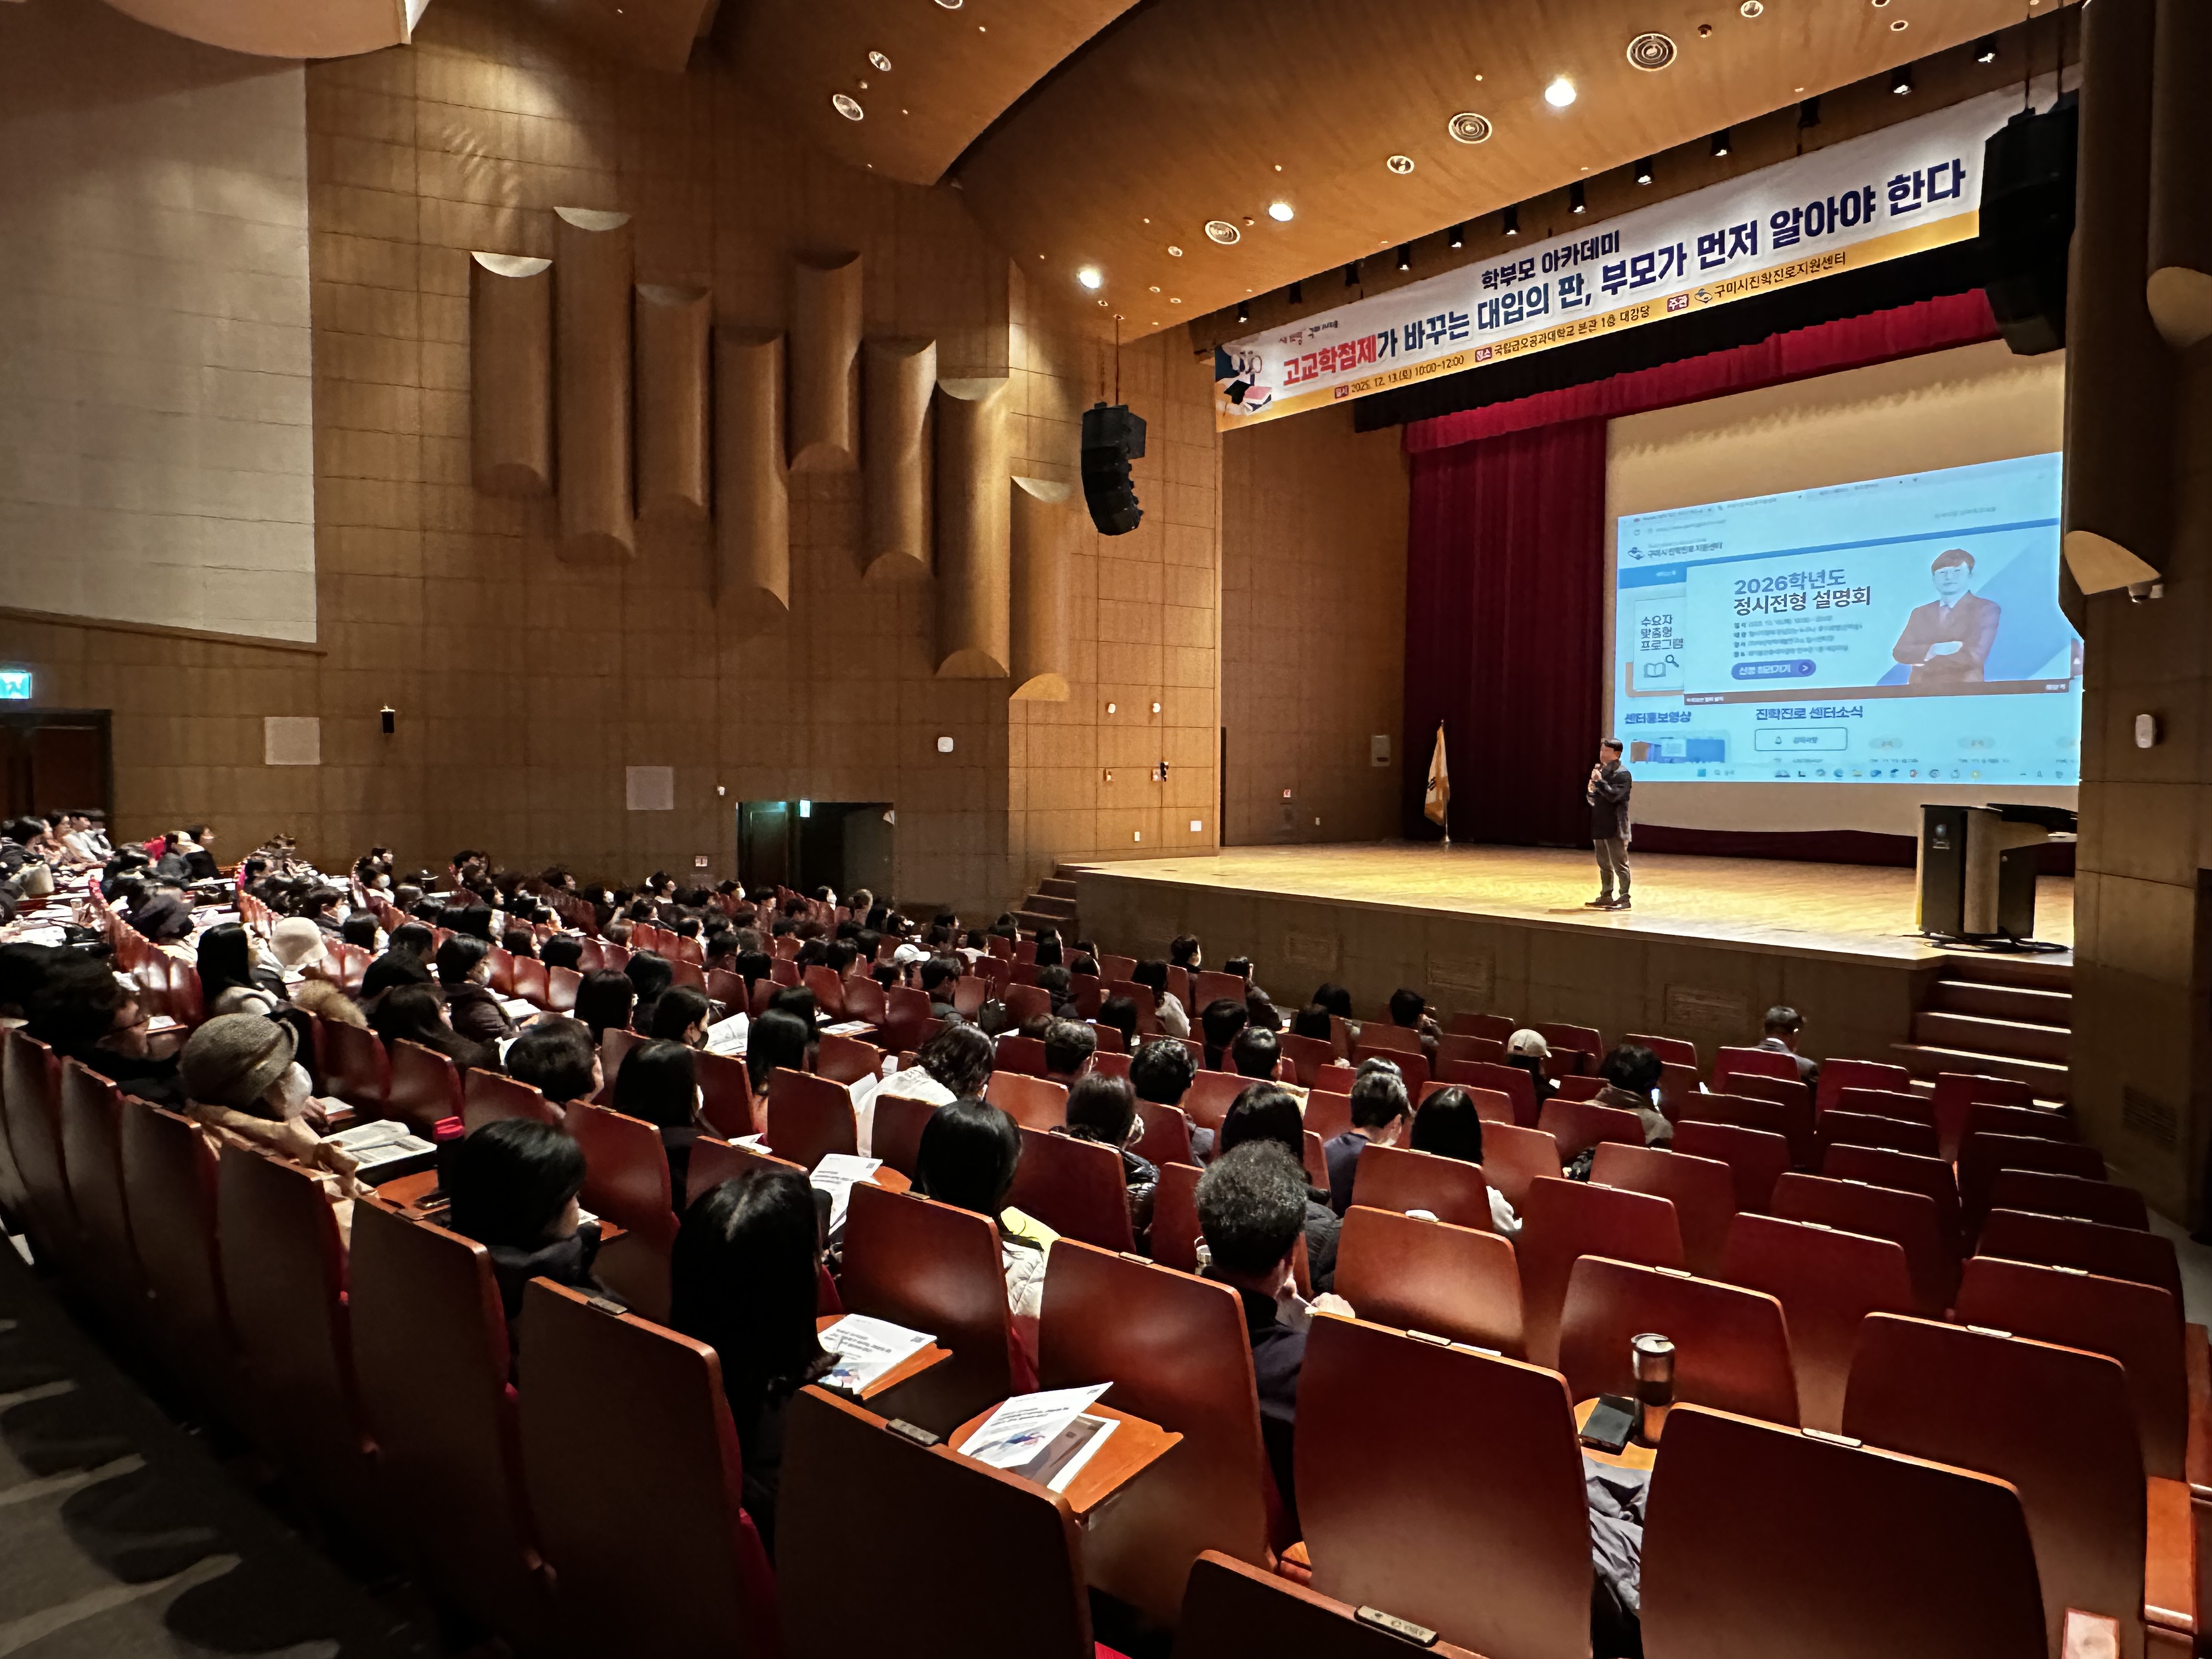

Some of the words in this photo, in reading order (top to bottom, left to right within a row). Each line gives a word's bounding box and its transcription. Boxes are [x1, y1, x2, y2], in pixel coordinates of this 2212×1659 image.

[1283, 329, 1397, 386] 고교학점제가
[1404, 311, 1470, 351] 바꾸는
[1477, 283, 1549, 330] 대입의
[1559, 273, 1592, 309] 판,
[1601, 242, 1687, 296] 부모가
[1697, 219, 1758, 270] 먼저
[1770, 185, 1876, 250] 알아야
[1887, 158, 1966, 217] 한다
[1482, 257, 1536, 290] 학부모
[1542, 229, 1620, 273] 아카데미
[1734, 569, 1846, 595] 2026학년도
[1734, 592, 1807, 616] 정시전형
[1813, 586, 1871, 610] 설명회
[1641, 614, 1673, 627] 수요자
